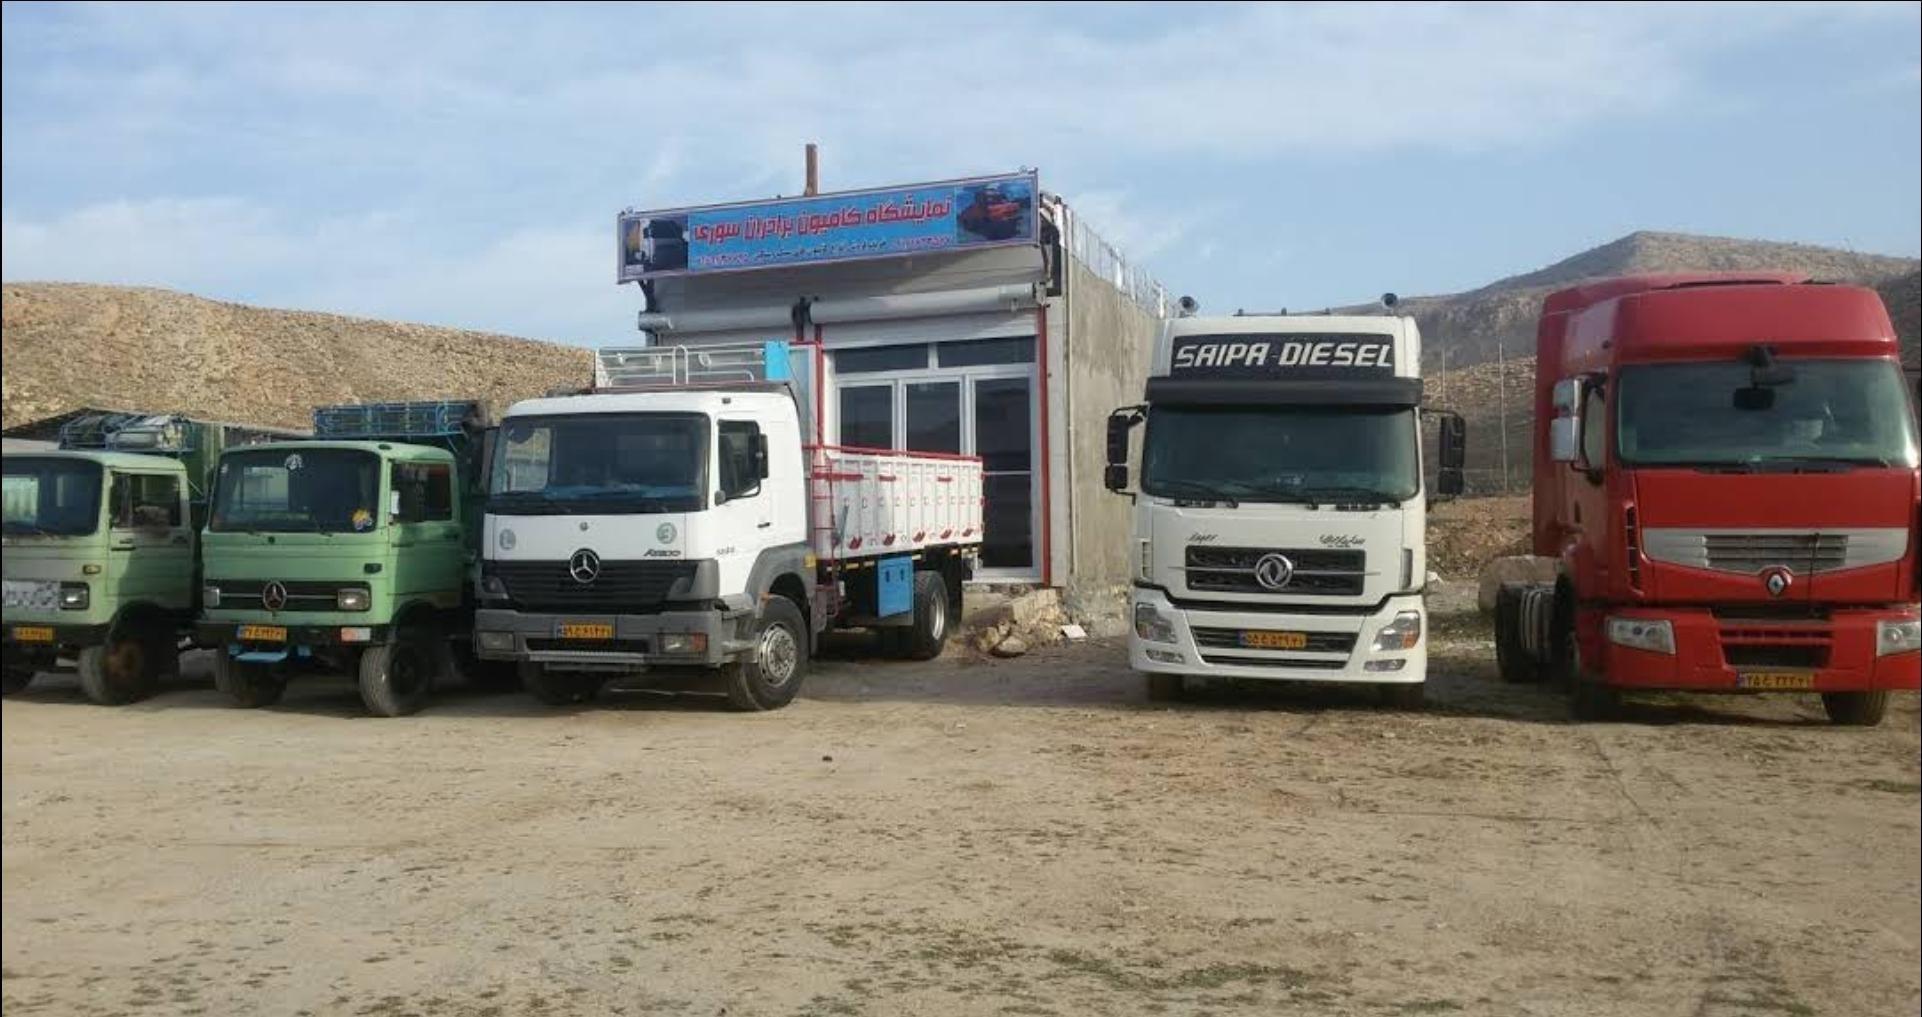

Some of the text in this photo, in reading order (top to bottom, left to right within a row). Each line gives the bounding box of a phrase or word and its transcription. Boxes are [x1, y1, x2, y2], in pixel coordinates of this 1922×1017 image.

[694, 194, 952, 245] نمایشگاه کامیون برادران سوری
[1174, 343, 1393, 367] SAIPA DIESEL
